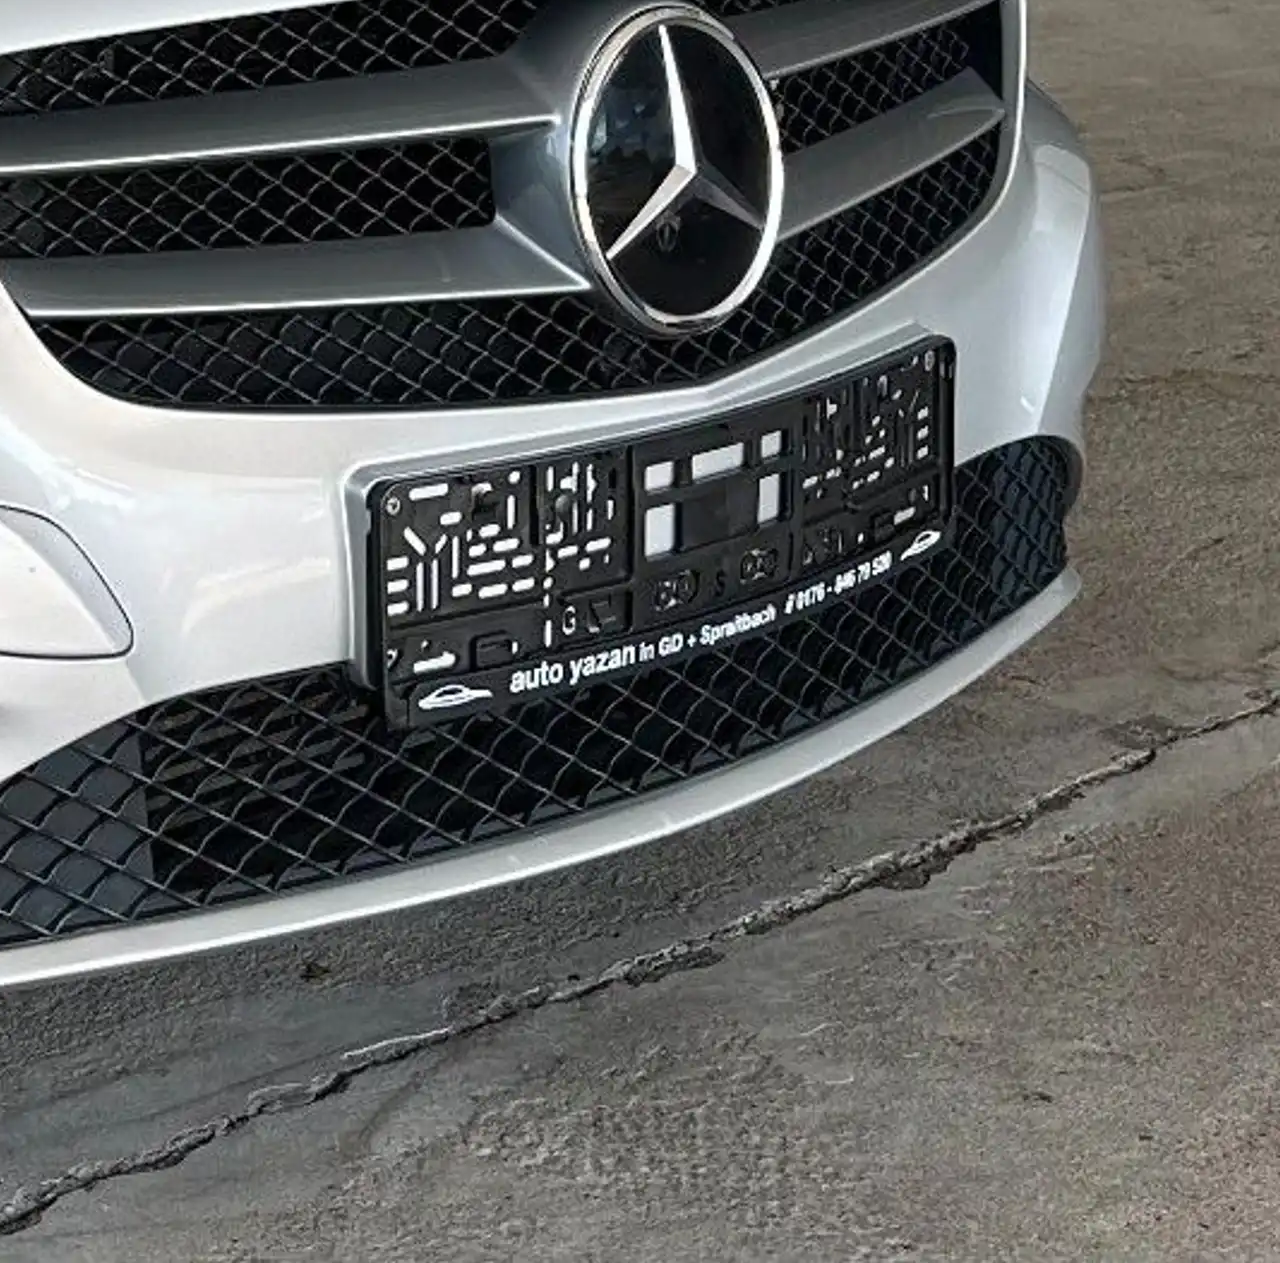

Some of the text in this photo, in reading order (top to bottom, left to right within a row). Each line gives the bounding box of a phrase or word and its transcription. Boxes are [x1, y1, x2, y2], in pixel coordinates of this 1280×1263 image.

[509, 660, 564, 693] auto
[569, 644, 636, 686] yazan
[638, 641, 655, 663] in
[658, 632, 684, 657] GD
